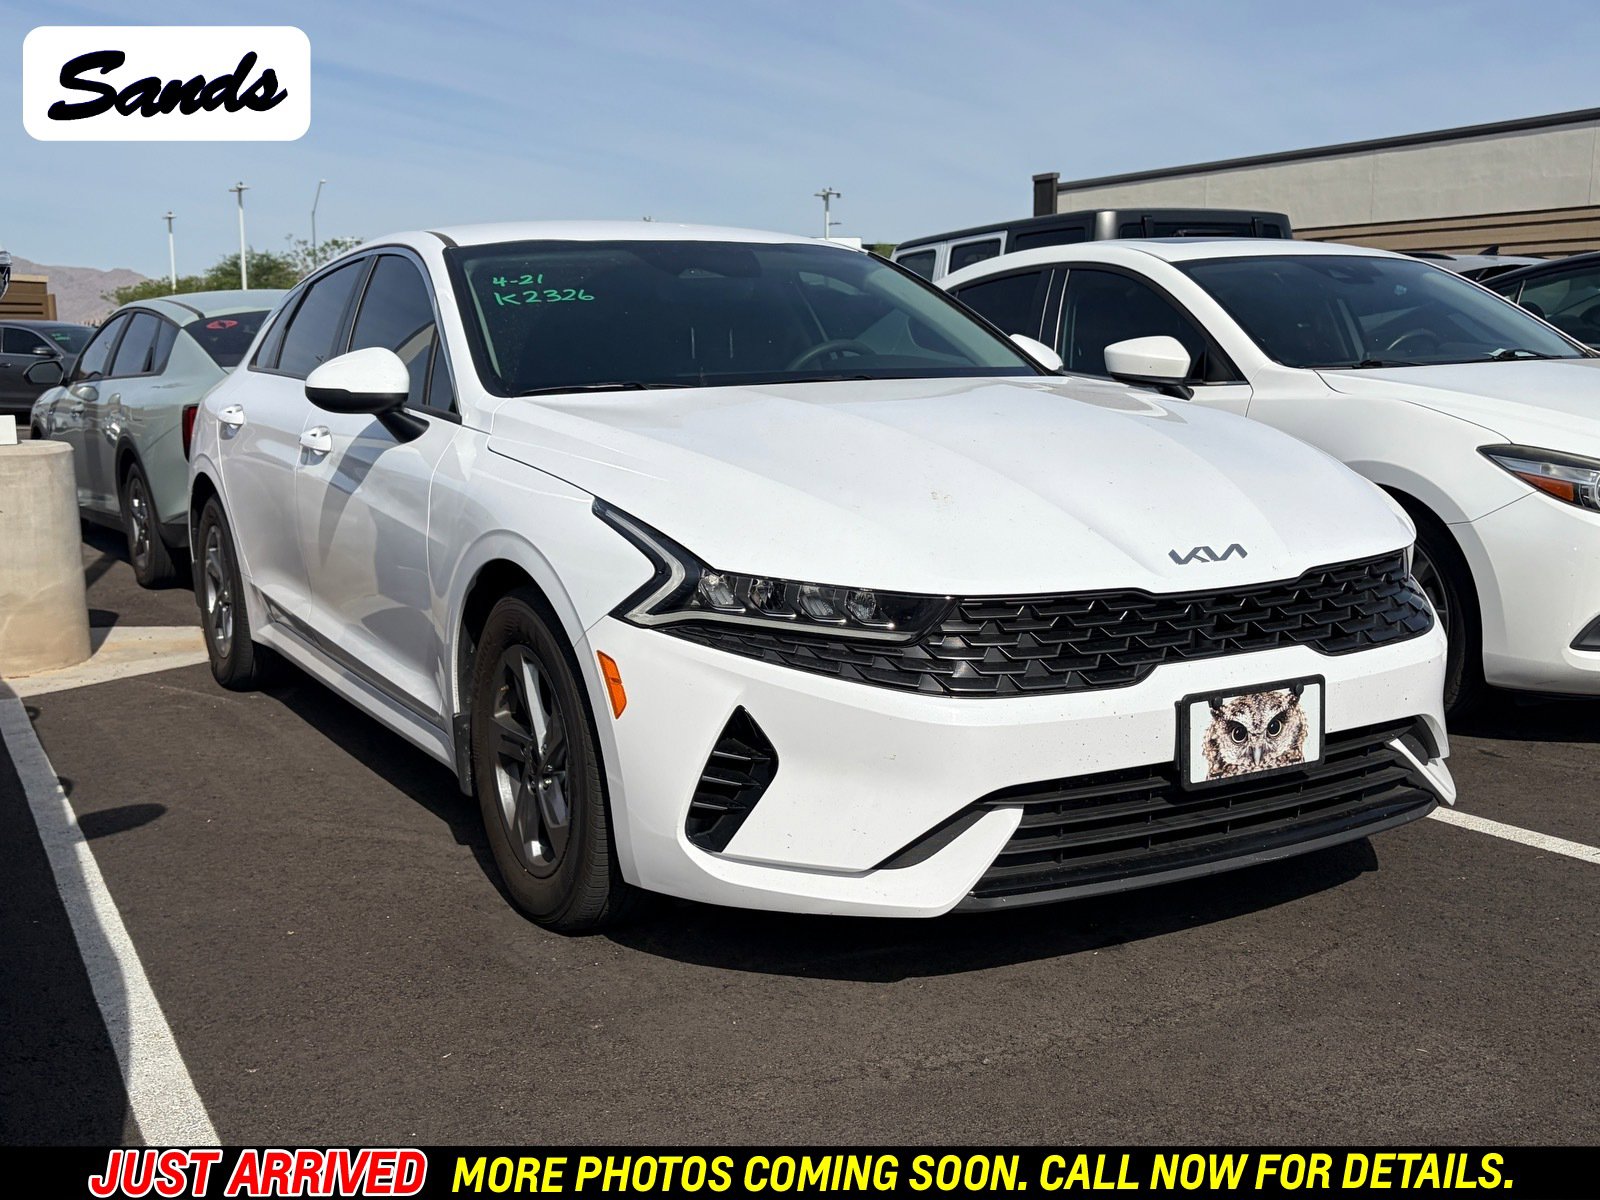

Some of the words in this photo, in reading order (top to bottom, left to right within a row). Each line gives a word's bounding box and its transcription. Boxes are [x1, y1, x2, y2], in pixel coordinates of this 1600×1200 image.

[492, 273, 544, 287] 4-21
[494, 288, 596, 306] K2326
[1168, 543, 1248, 565] KIA
